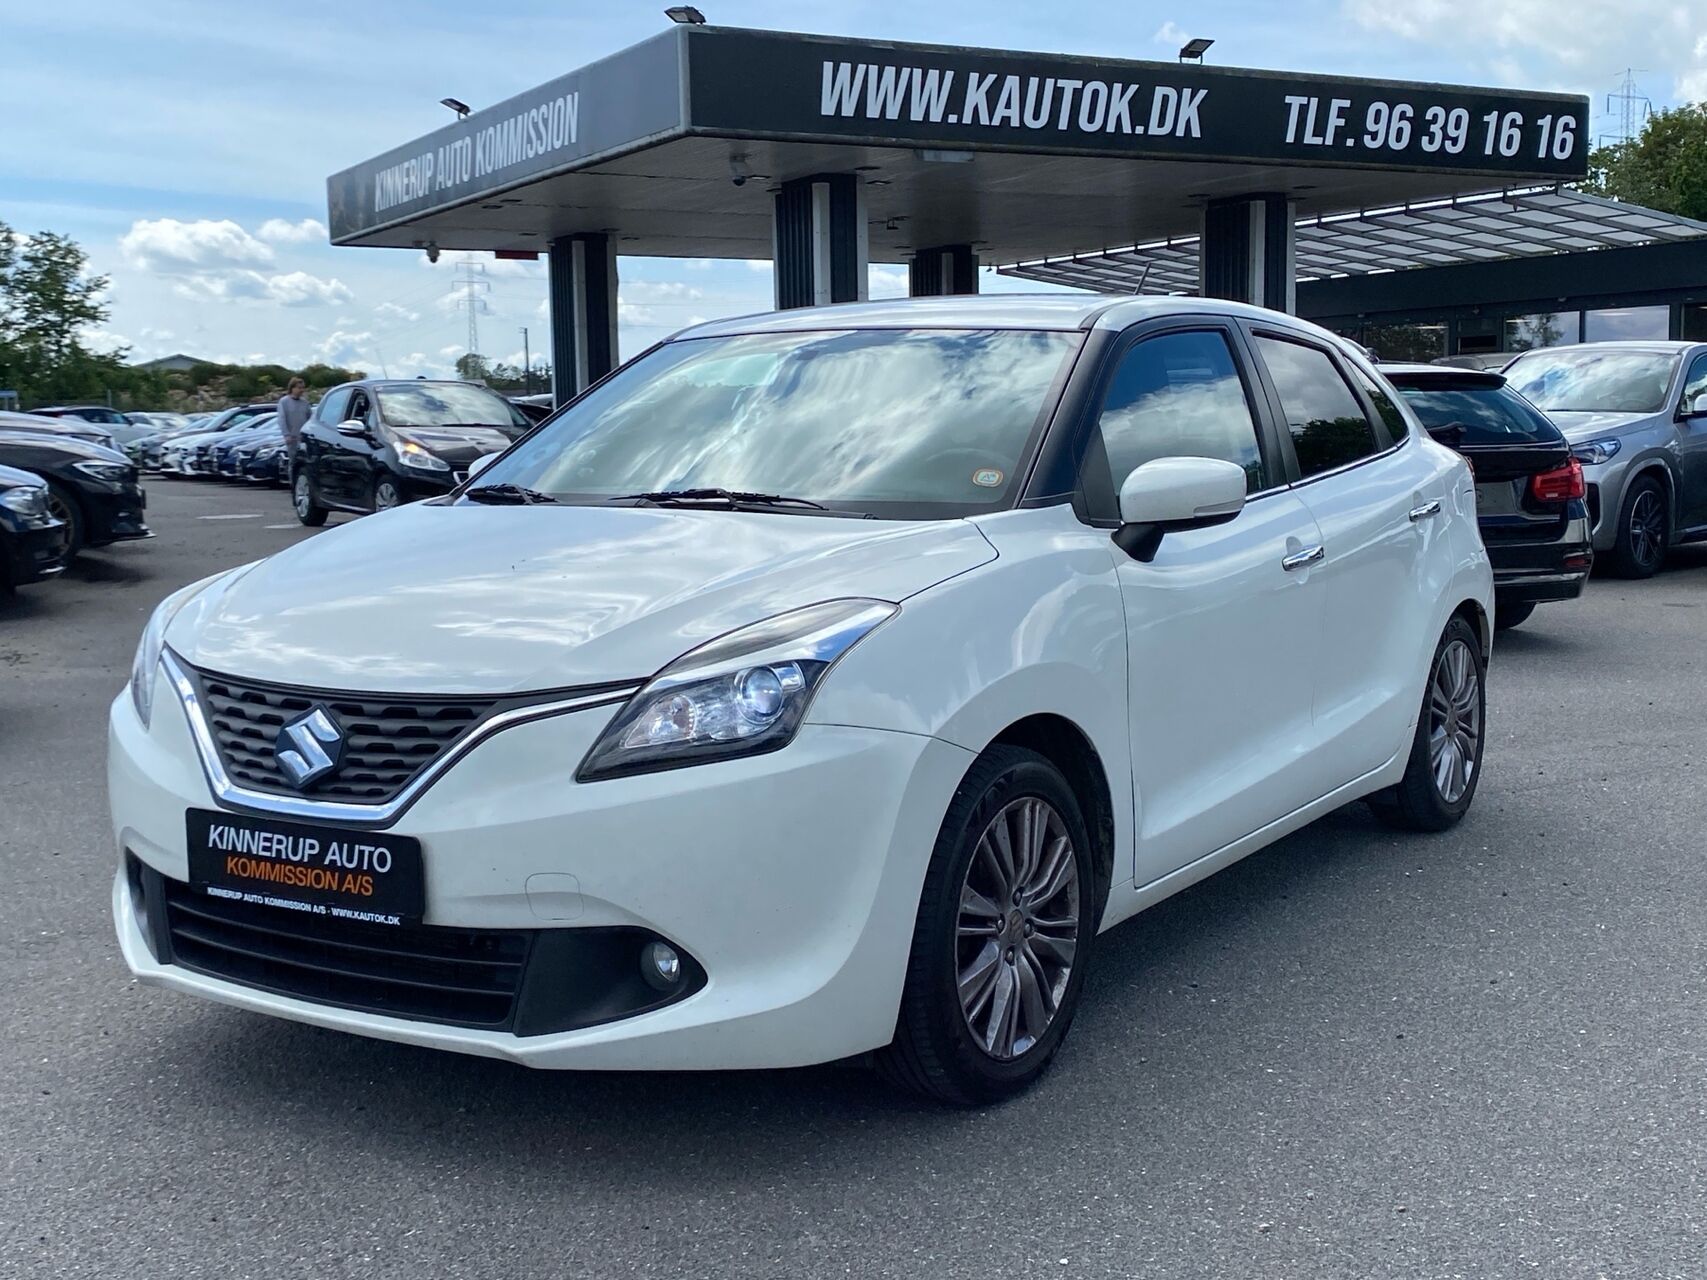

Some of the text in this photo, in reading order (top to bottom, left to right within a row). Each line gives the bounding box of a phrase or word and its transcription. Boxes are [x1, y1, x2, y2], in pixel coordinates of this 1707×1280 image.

[820, 61, 1208, 138] WWW.KAUTOK.DK
[1284, 95, 1577, 160] TLF. 96 39 16 16
[375, 91, 579, 212] KINNERUP AUTO KOMMISSION
[208, 824, 392, 873] KINNERUP AUTO
[227, 856, 374, 896] KOMMISSION A/S
[206, 886, 243, 900] KINNERUP
[243, 893, 264, 904] AUTO
[264, 896, 312, 912] KOMMISSION
[312, 904, 326, 914] A/S
[331, 907, 401, 926] WWW.KAUTOK.DK
